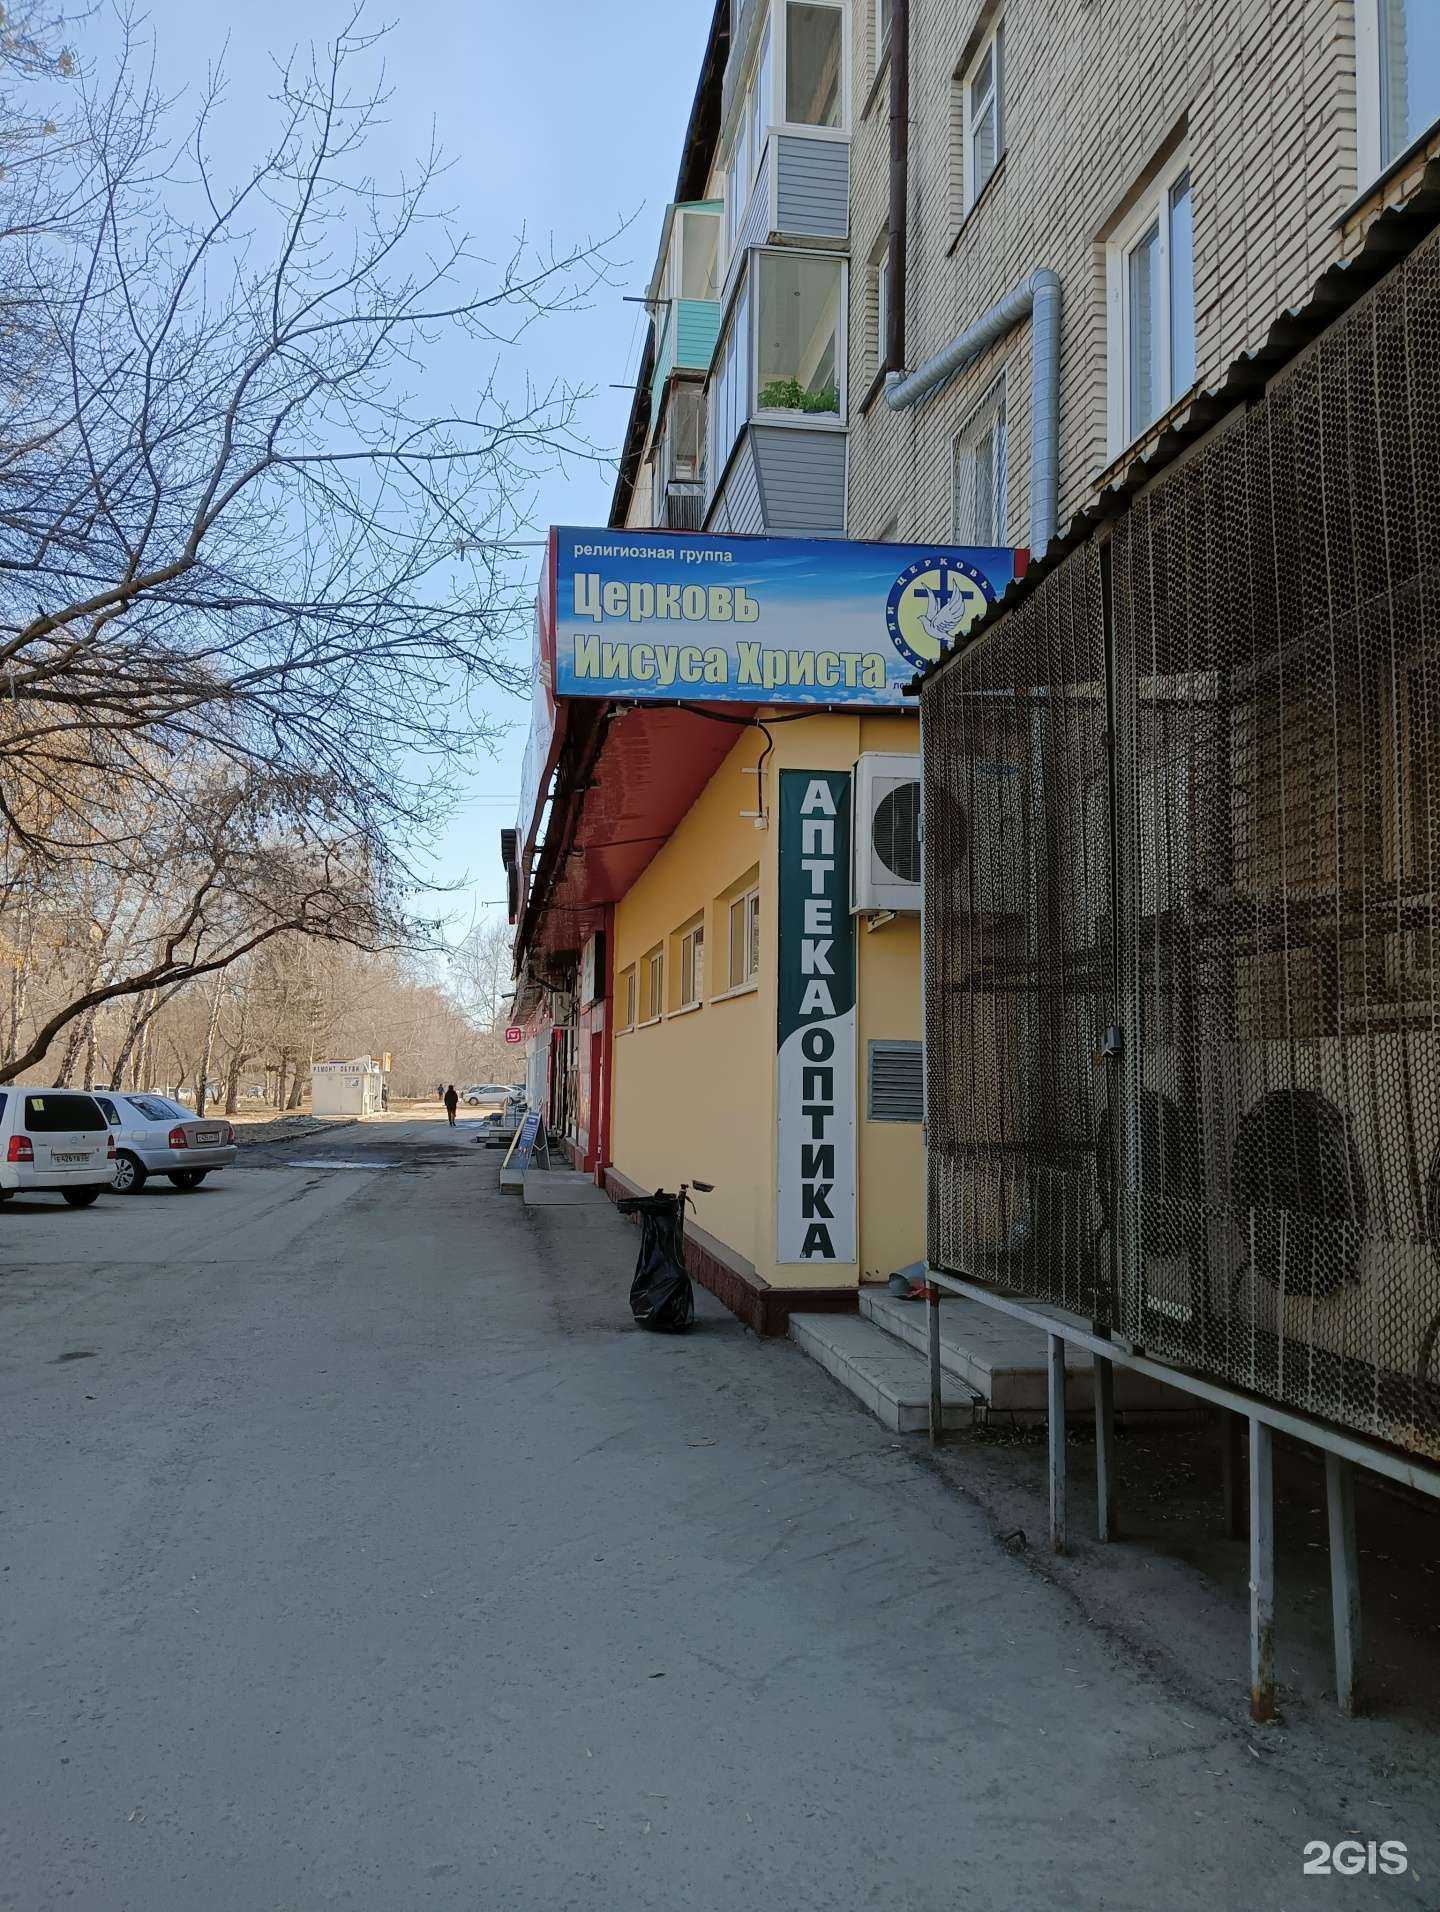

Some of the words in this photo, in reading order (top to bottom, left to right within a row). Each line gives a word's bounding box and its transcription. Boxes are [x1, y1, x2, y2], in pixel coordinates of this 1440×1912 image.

[574, 543, 675, 560] религиозная
[679, 547, 733, 563] группа
[896, 557, 989, 590] ЦЕРКОВЬ
[573, 572, 760, 623] Церковь
[573, 634, 729, 686] Иисуса
[736, 641, 887, 690] Христа
[799, 779, 838, 1016] АПТЕКА
[800, 1027, 837, 1259] ОПТИКА
